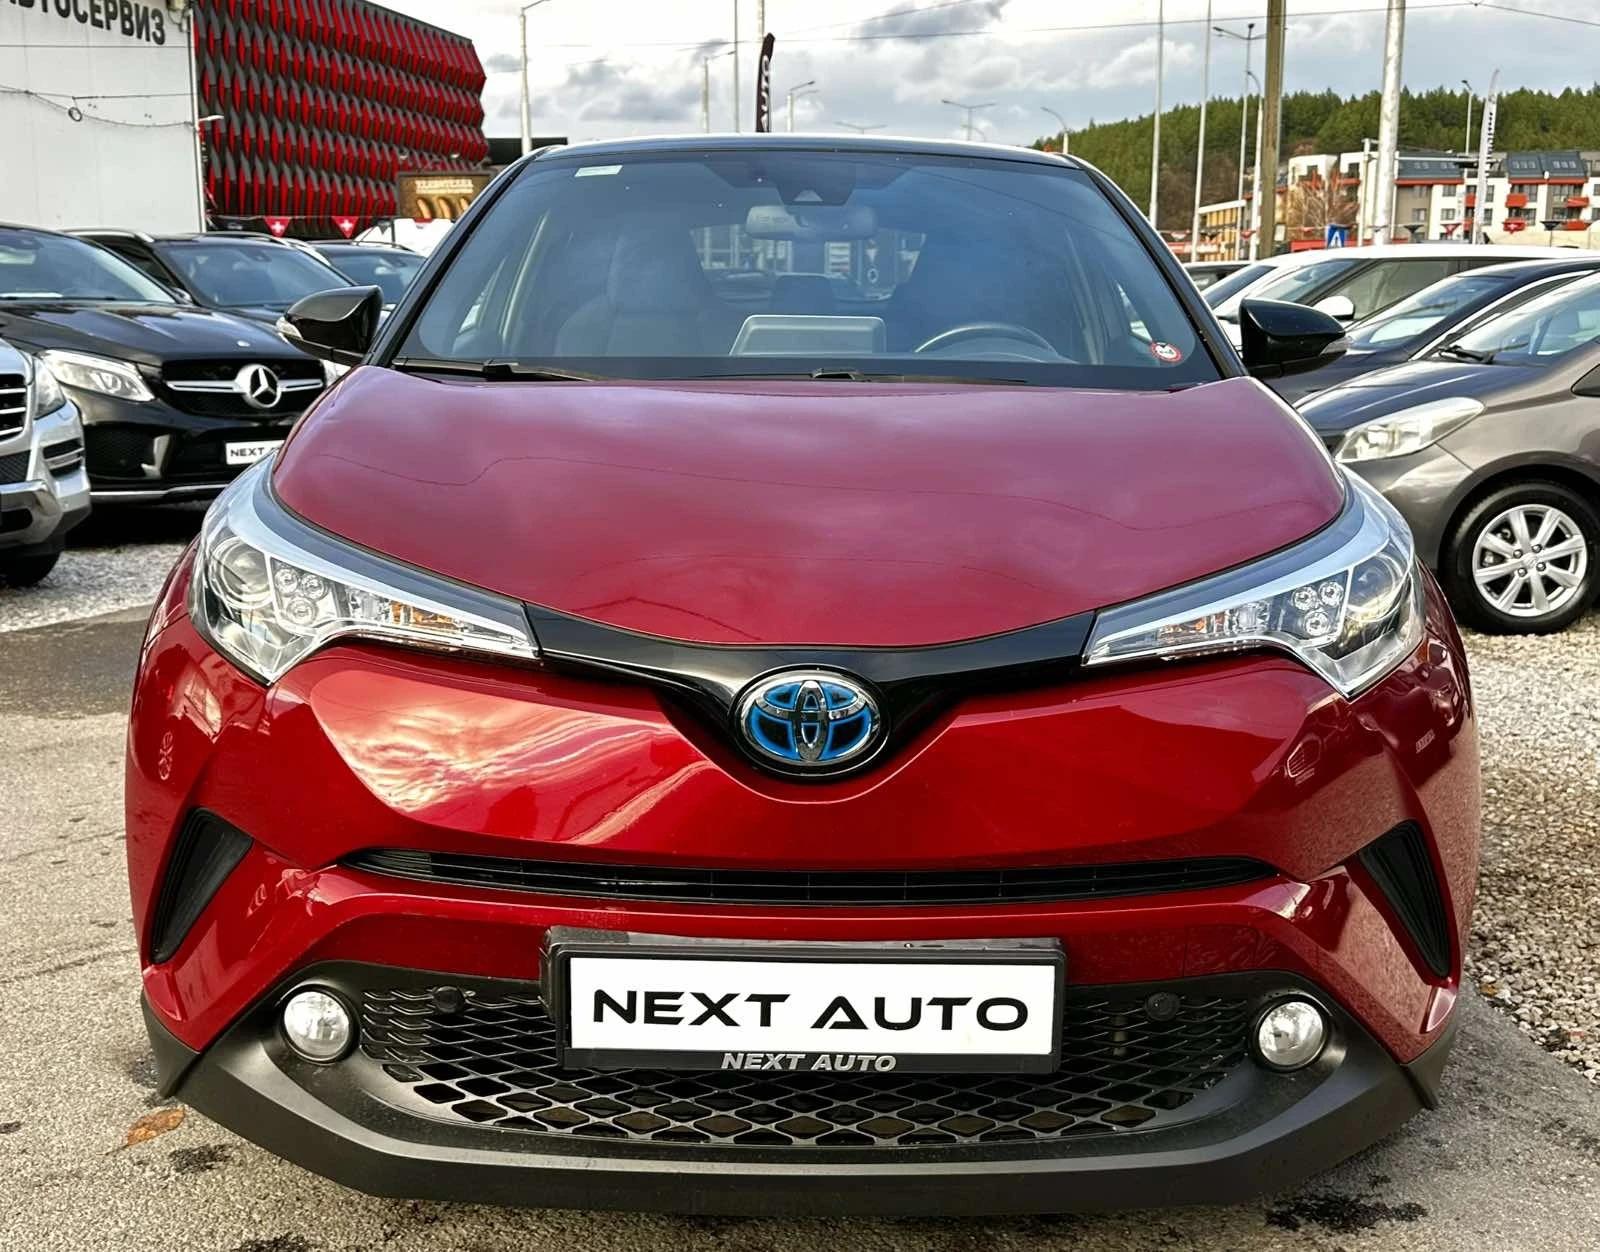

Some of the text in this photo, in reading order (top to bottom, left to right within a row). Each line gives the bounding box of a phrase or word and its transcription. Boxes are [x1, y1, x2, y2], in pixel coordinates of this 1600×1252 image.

[9, 0, 165, 45] СЕРВИЗ
[230, 447, 264, 457] NEXT
[593, 989, 1029, 1032] NEXT AUTO
[720, 1052, 897, 1072] NEXT AUTO
